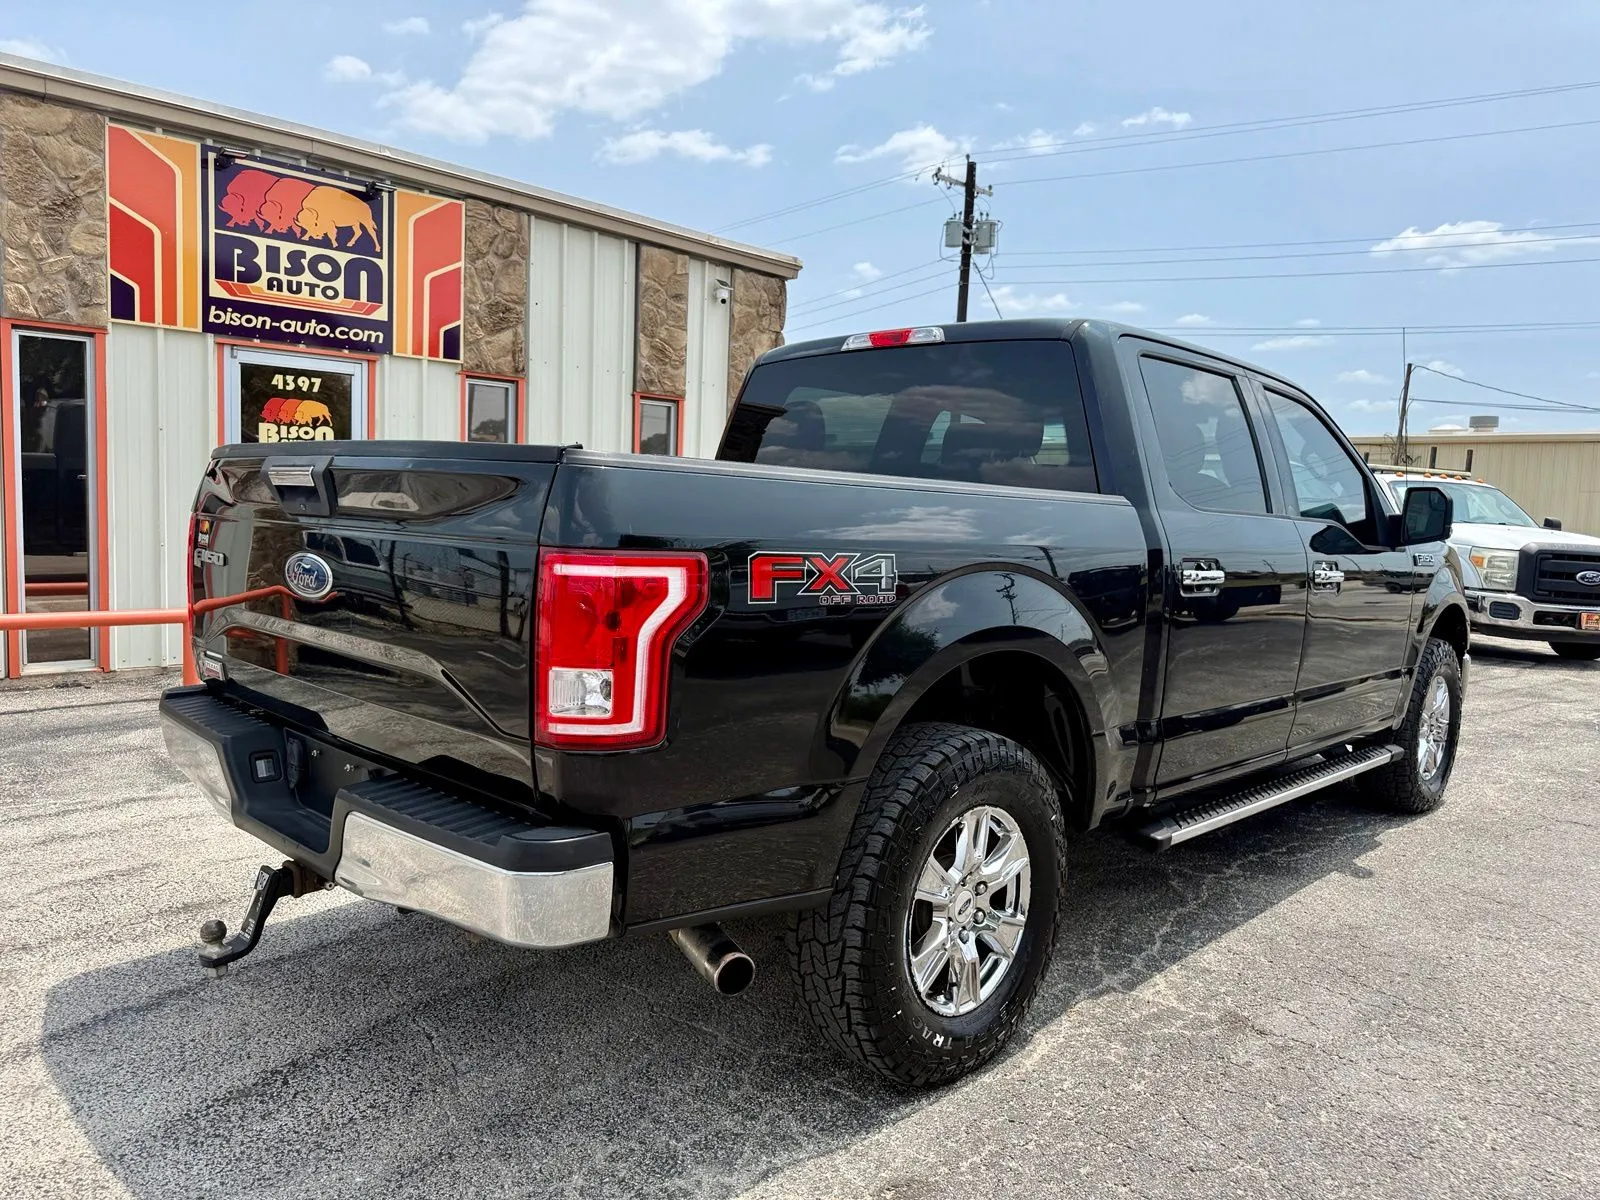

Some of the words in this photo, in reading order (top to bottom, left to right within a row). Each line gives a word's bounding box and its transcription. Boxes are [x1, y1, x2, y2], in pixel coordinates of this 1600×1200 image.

[266, 276, 340, 301] AUTO
[208, 305, 384, 344] bison-auto.com
[271, 374, 322, 393] 4397
[748, 551, 898, 605] FX4
[819, 595, 851, 606] OFF
[856, 595, 897, 605] ROAD
